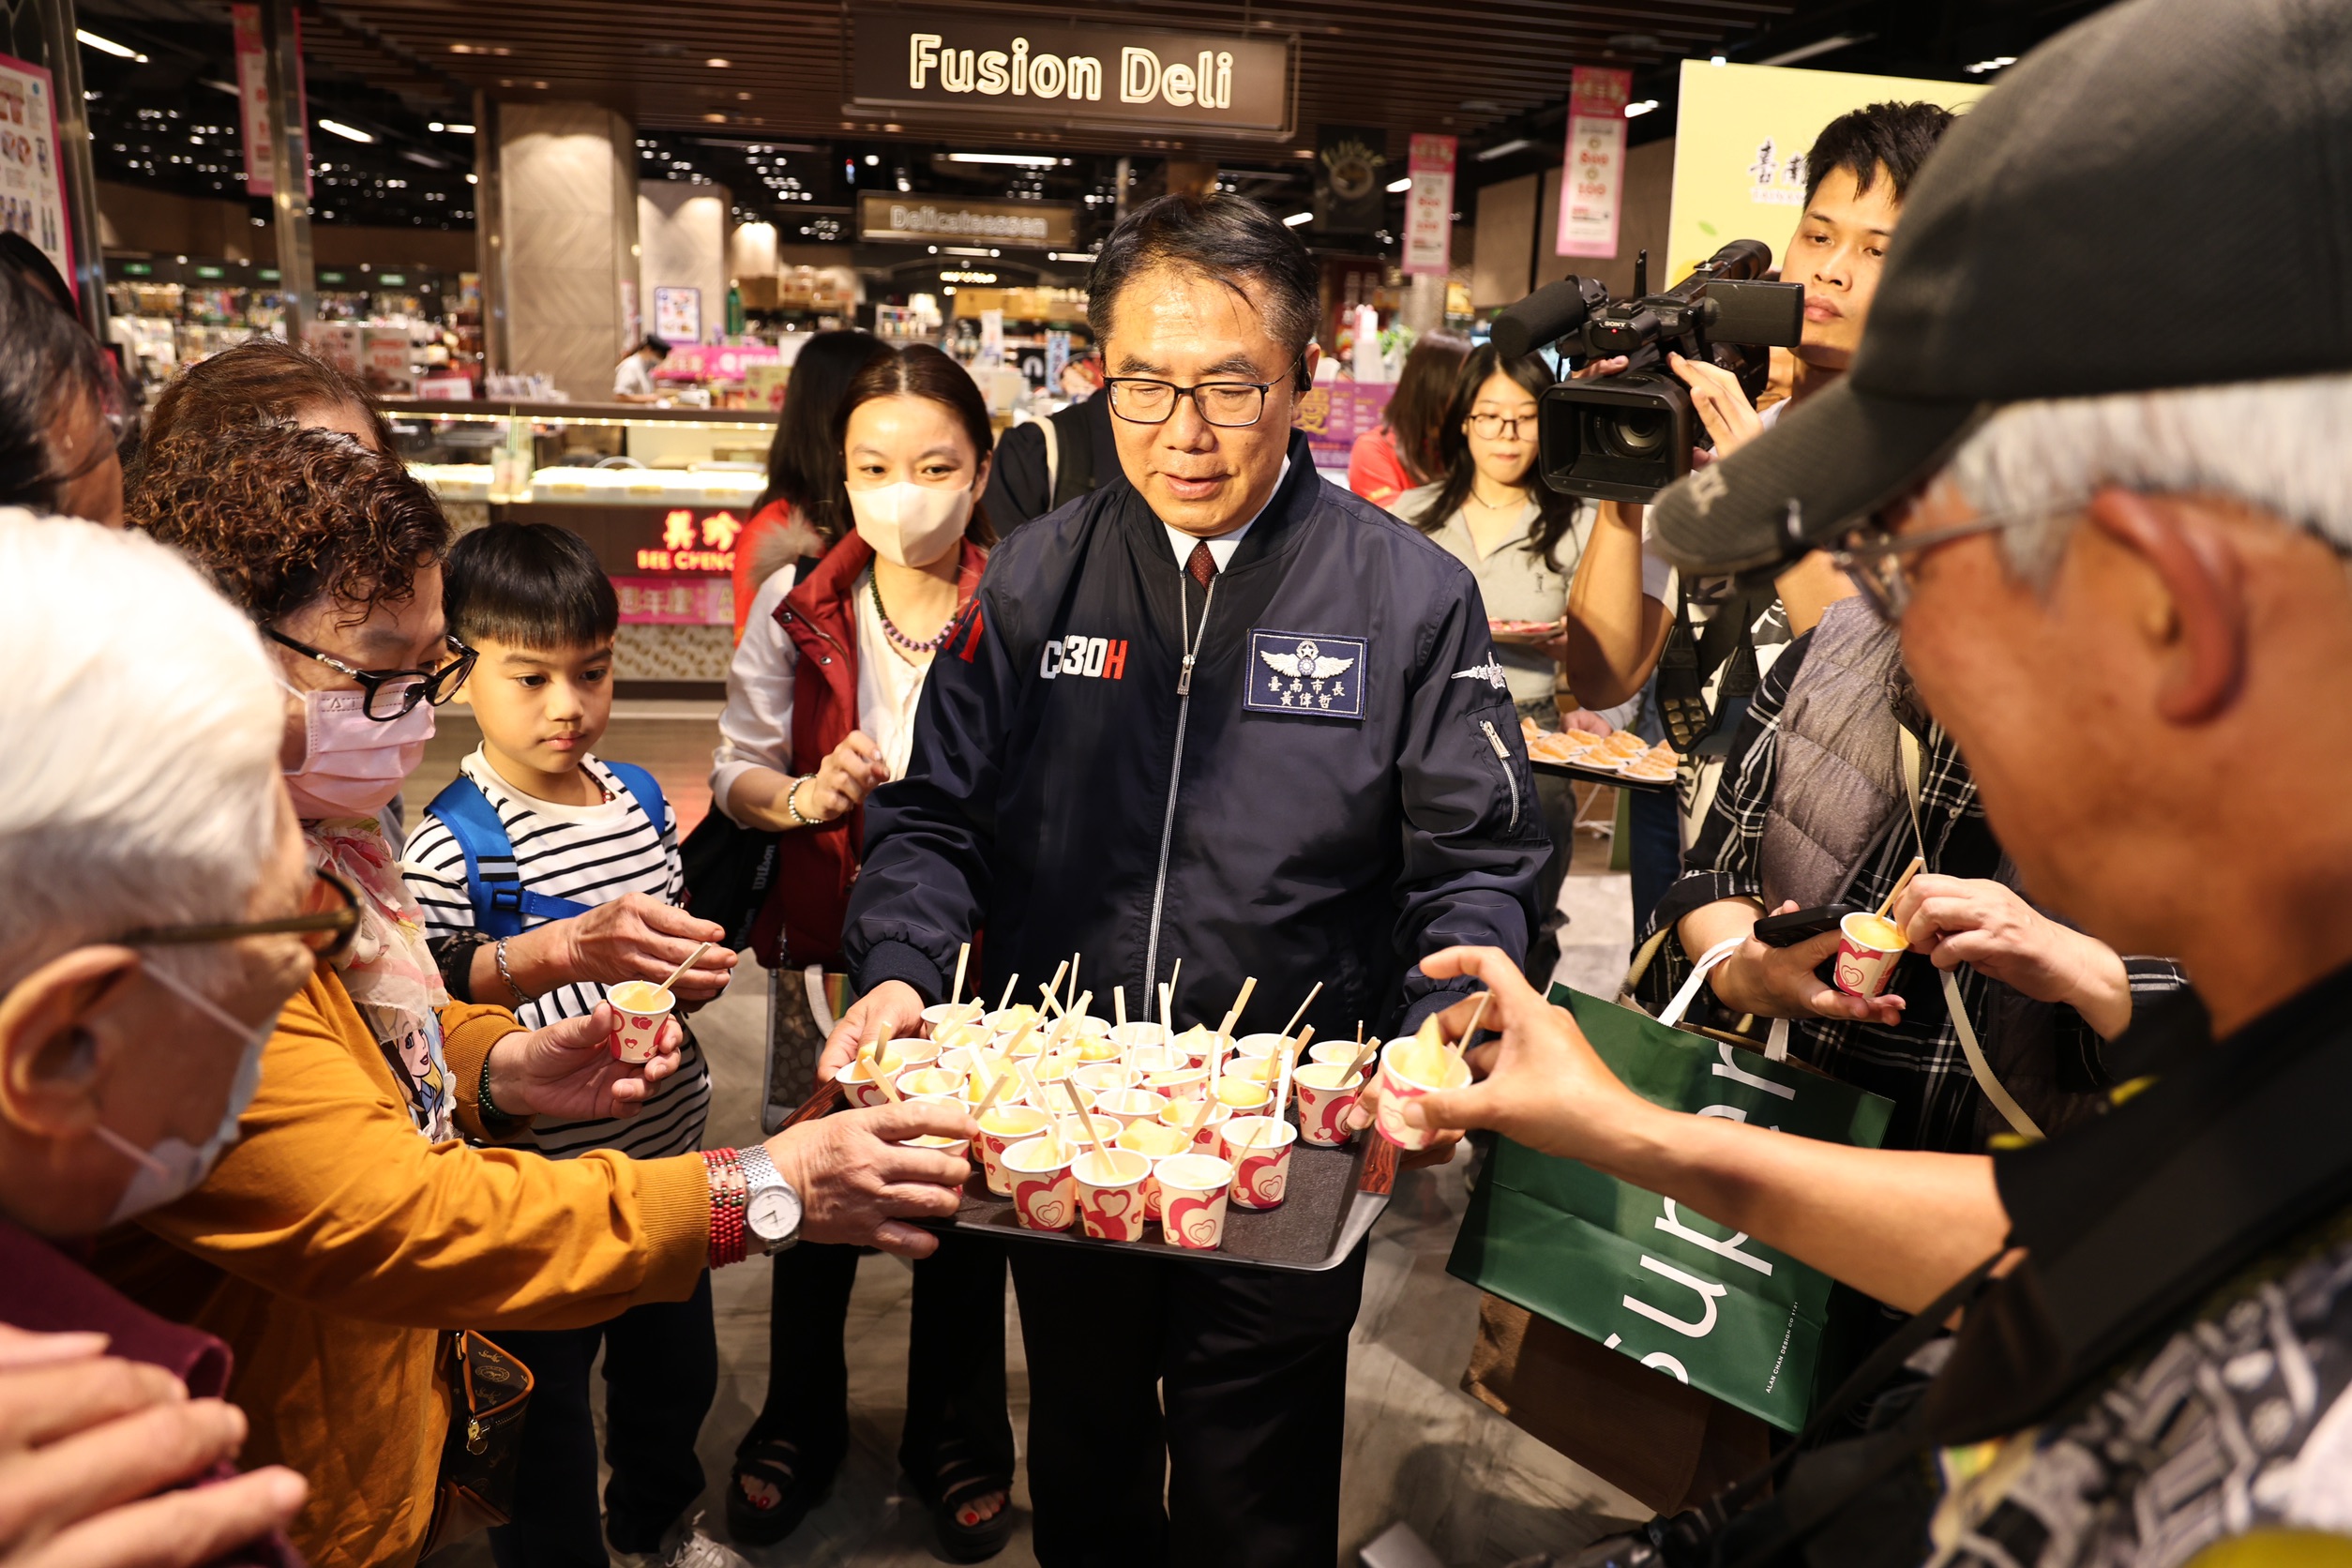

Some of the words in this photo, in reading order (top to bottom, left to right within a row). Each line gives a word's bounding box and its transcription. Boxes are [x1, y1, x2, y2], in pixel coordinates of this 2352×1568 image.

[909, 33, 1103, 100] Fusion
[1119, 46, 1235, 110] Deli
[1604, 320, 1627, 328] SONY
[637, 550, 671, 570] BEE
[751, 844, 776, 890] Wilson
[1765, 1375, 1777, 1394] ALAN
[1772, 1355, 1784, 1375] CHAN
[1780, 1329, 1792, 1355] DESIGN
